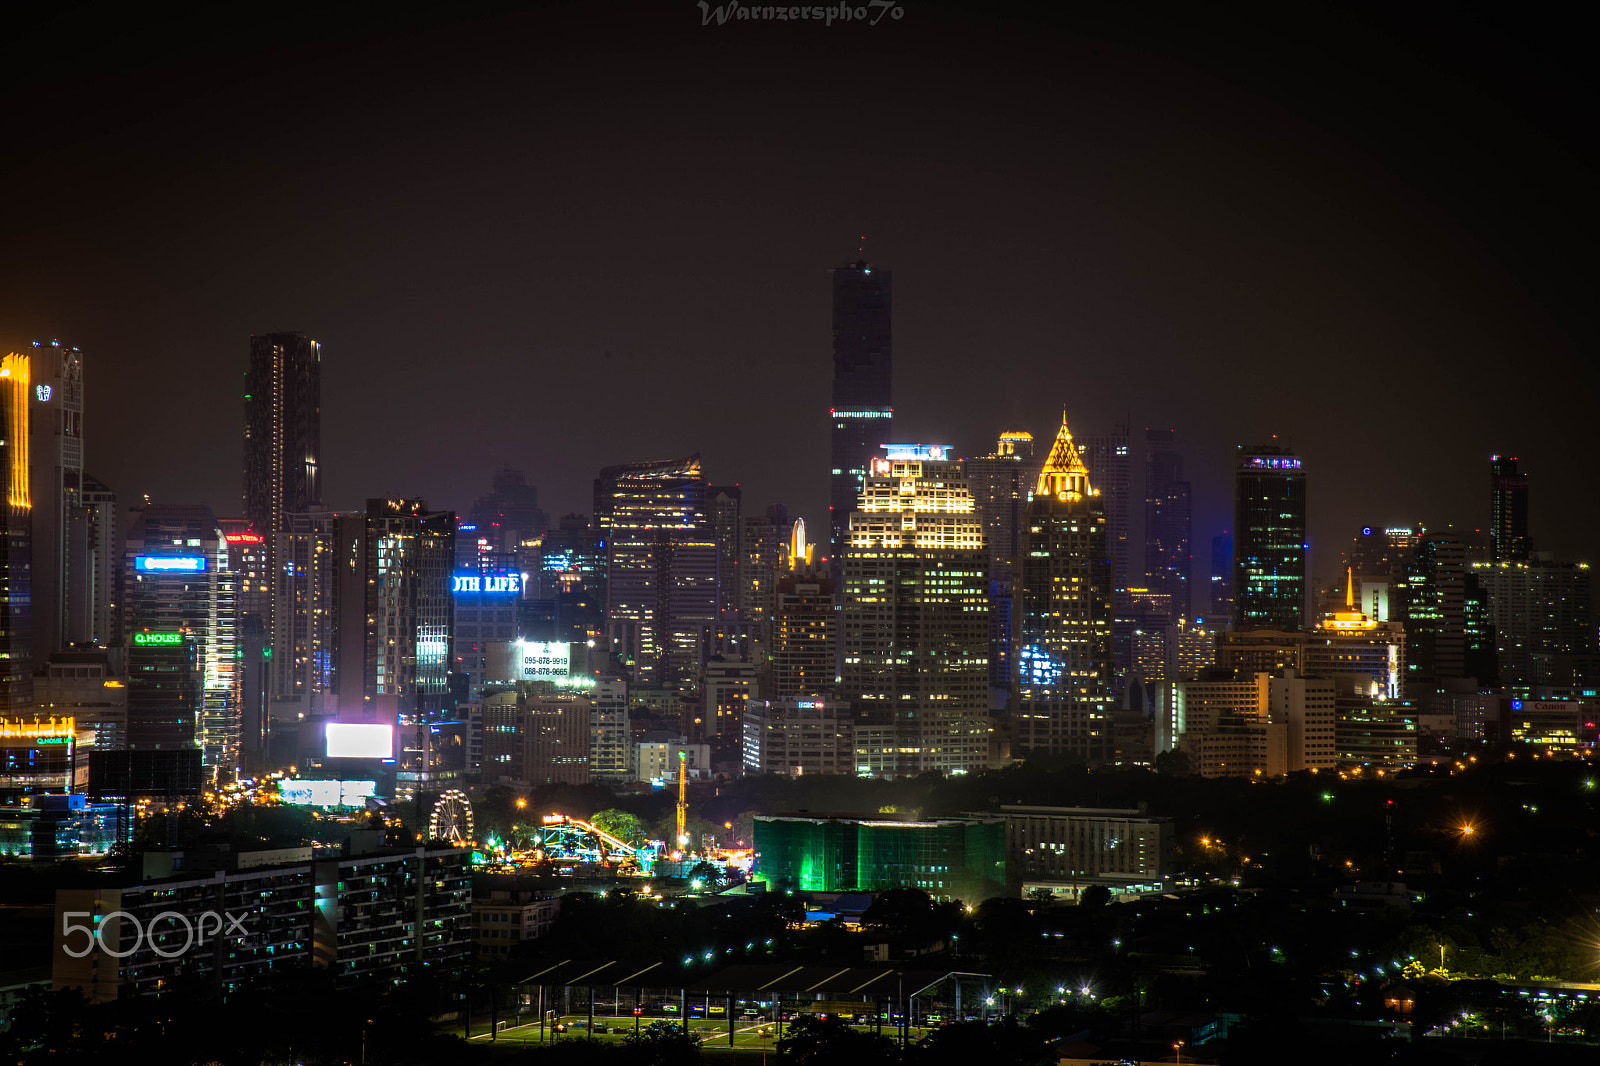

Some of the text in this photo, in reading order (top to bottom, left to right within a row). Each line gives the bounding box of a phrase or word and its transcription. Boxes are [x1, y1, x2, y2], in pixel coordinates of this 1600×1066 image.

[484, 576, 519, 591] LIFE
[135, 634, 182, 643] Q.HOUSE
[524, 656, 568, 665] 095-878-9919
[1534, 702, 1566, 710] Canon
